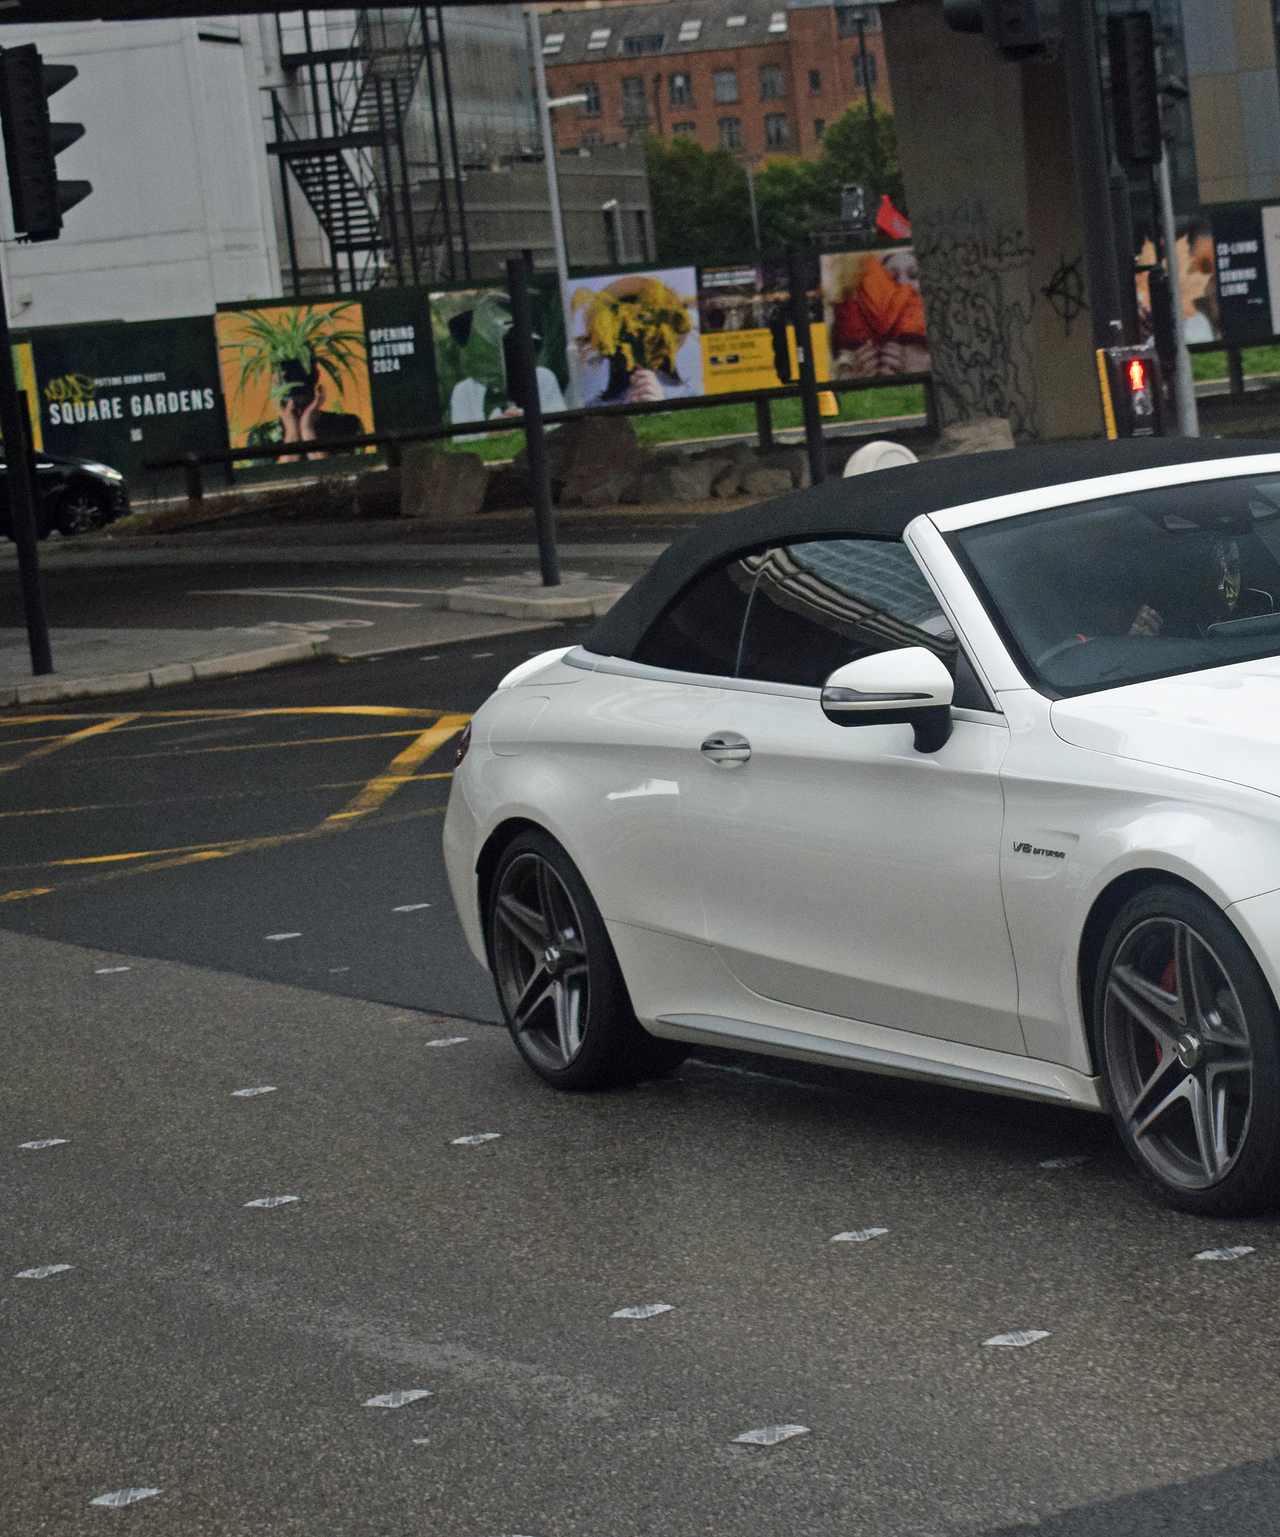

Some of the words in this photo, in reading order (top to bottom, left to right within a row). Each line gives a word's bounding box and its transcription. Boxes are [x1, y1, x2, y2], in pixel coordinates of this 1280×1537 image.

[369, 324, 415, 343] OPENING
[371, 341, 415, 358] AUTUMN
[373, 357, 400, 374] 2024
[49, 397, 124, 425] SQUARE
[130, 387, 215, 417] GARDENS
